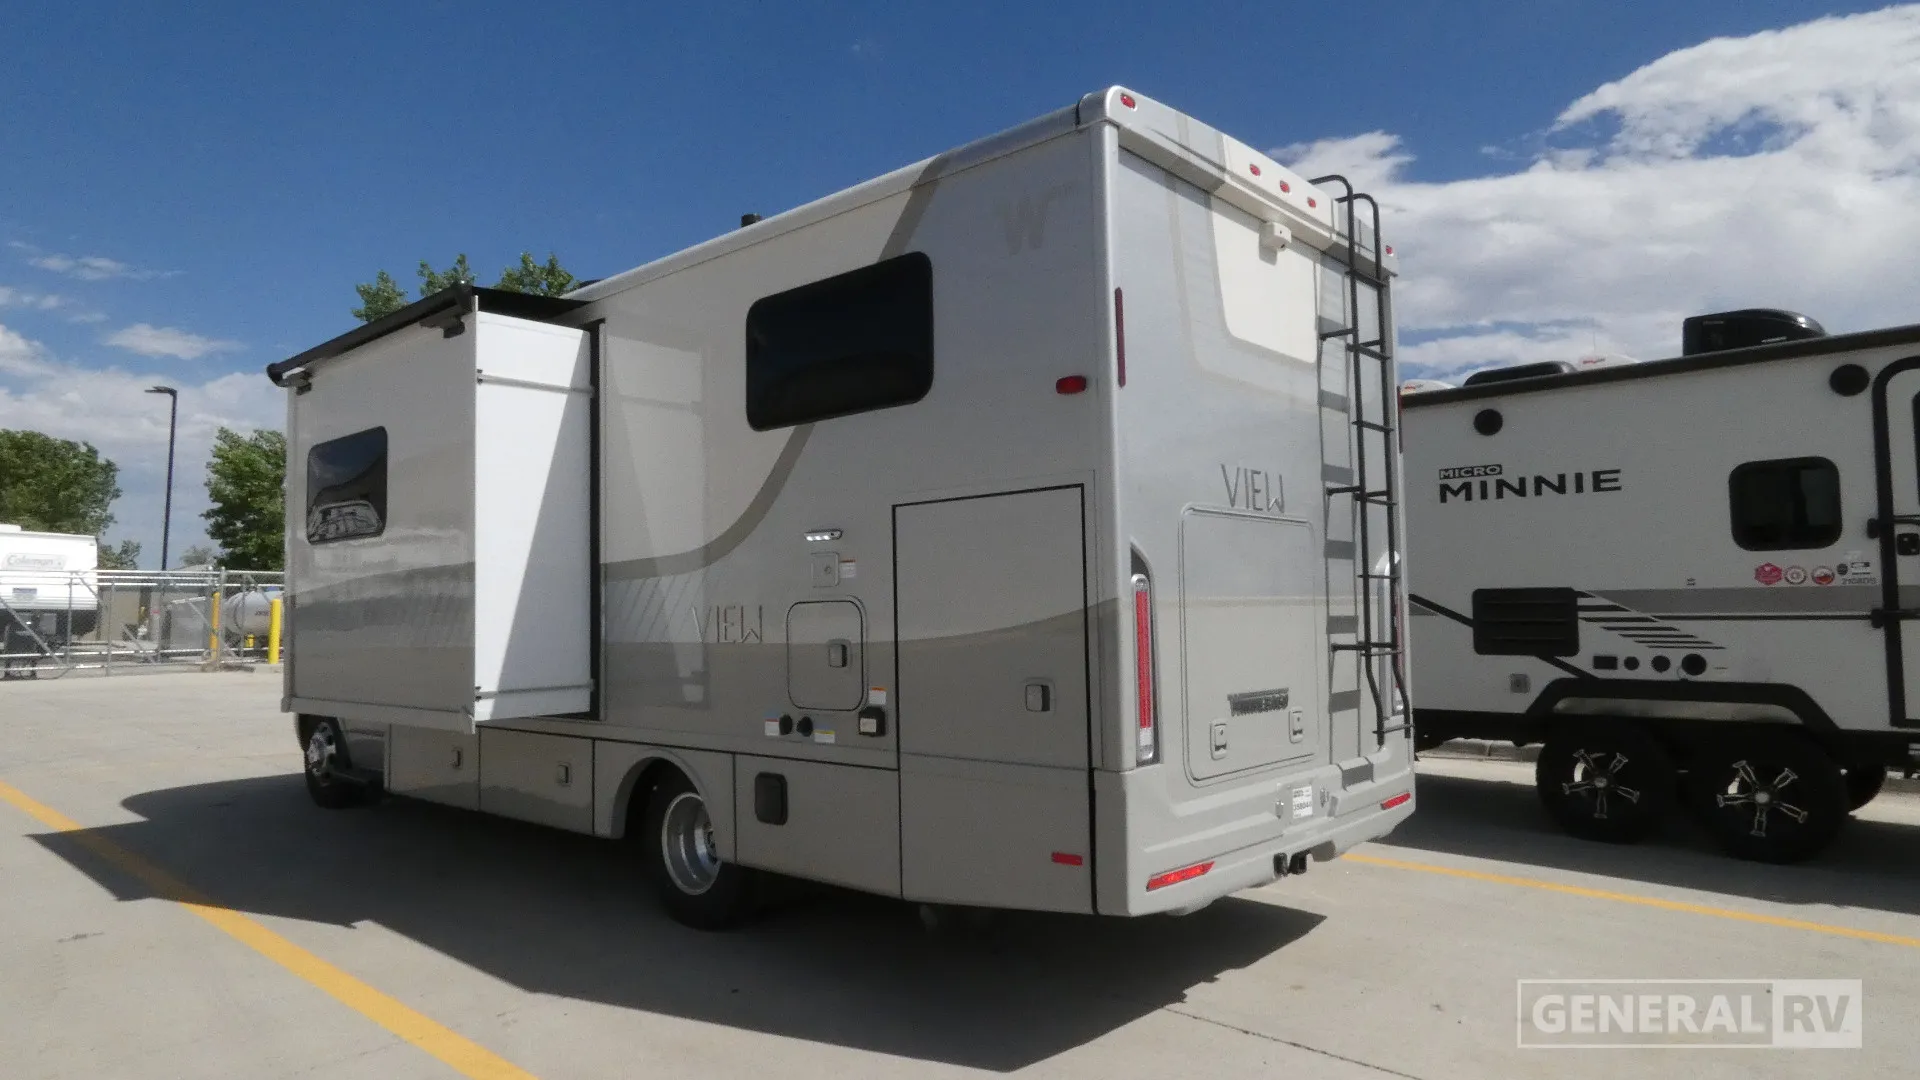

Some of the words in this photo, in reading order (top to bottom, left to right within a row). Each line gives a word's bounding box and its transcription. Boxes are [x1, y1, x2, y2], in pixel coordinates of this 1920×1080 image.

[1221, 463, 1285, 513] VIEW
[1440, 465, 1501, 479] MICRO
[1440, 469, 1622, 503] MINNIE
[691, 605, 763, 643] VIEW
